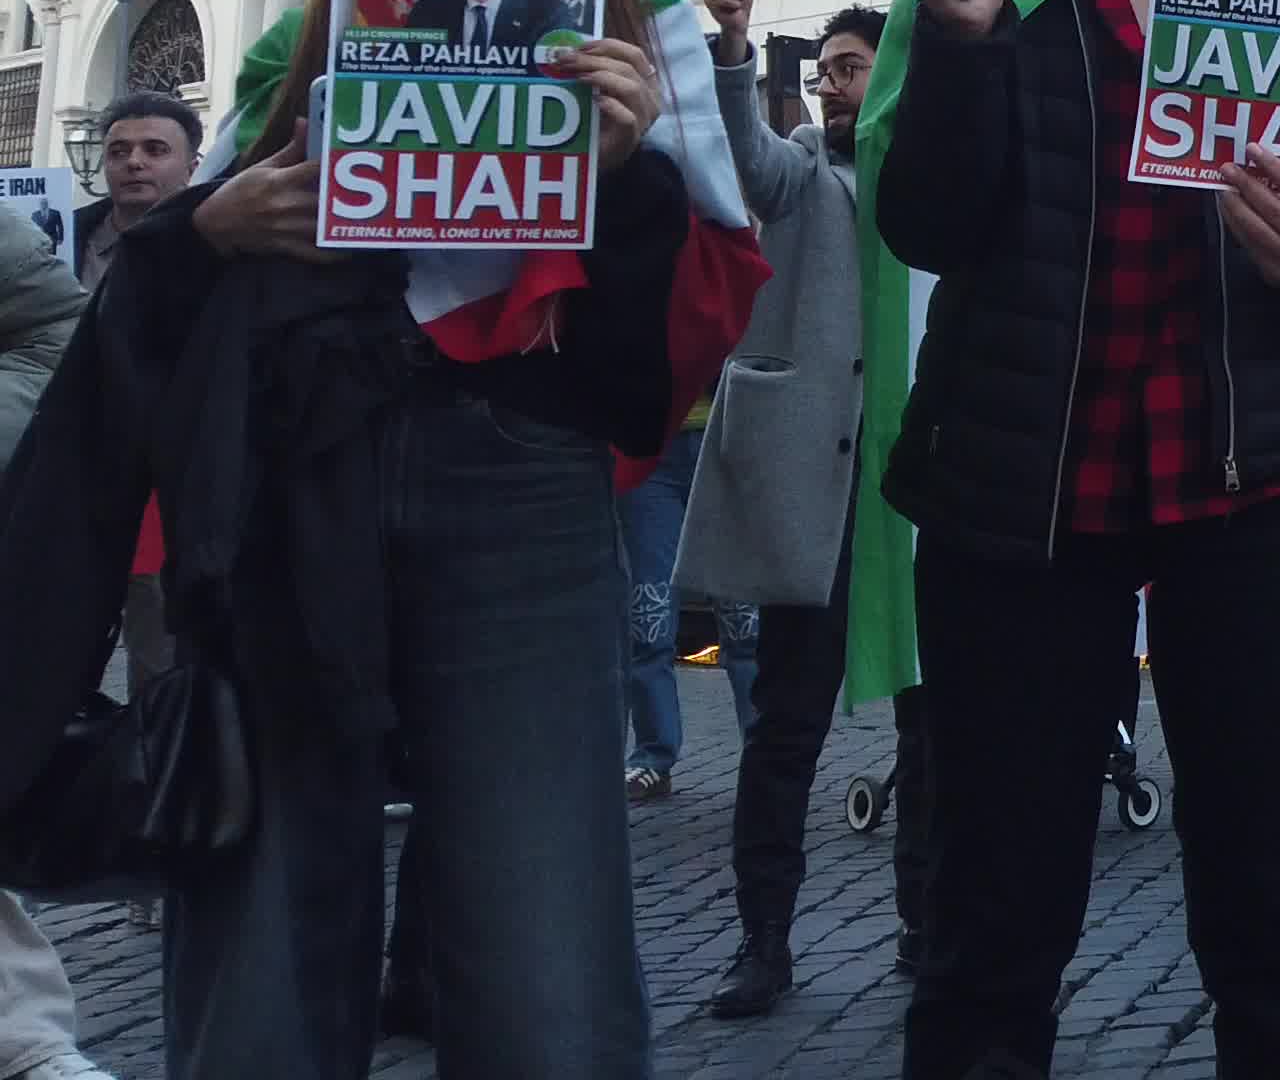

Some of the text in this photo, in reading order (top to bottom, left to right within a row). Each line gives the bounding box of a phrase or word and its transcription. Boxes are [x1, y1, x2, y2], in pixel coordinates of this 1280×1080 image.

[1161, 5, 1176, 13] The
[341, 41, 528, 66] REZA PAHLAVI
[336, 80, 581, 147] JAVID
[1141, 163, 1197, 178] ETERNAL
[1198, 169, 1225, 181] KIN
[9, 177, 46, 196] IRAN
[331, 151, 579, 221] SHAH
[331, 226, 579, 240] ETERNAL KING, LONG LIVE THE KING
